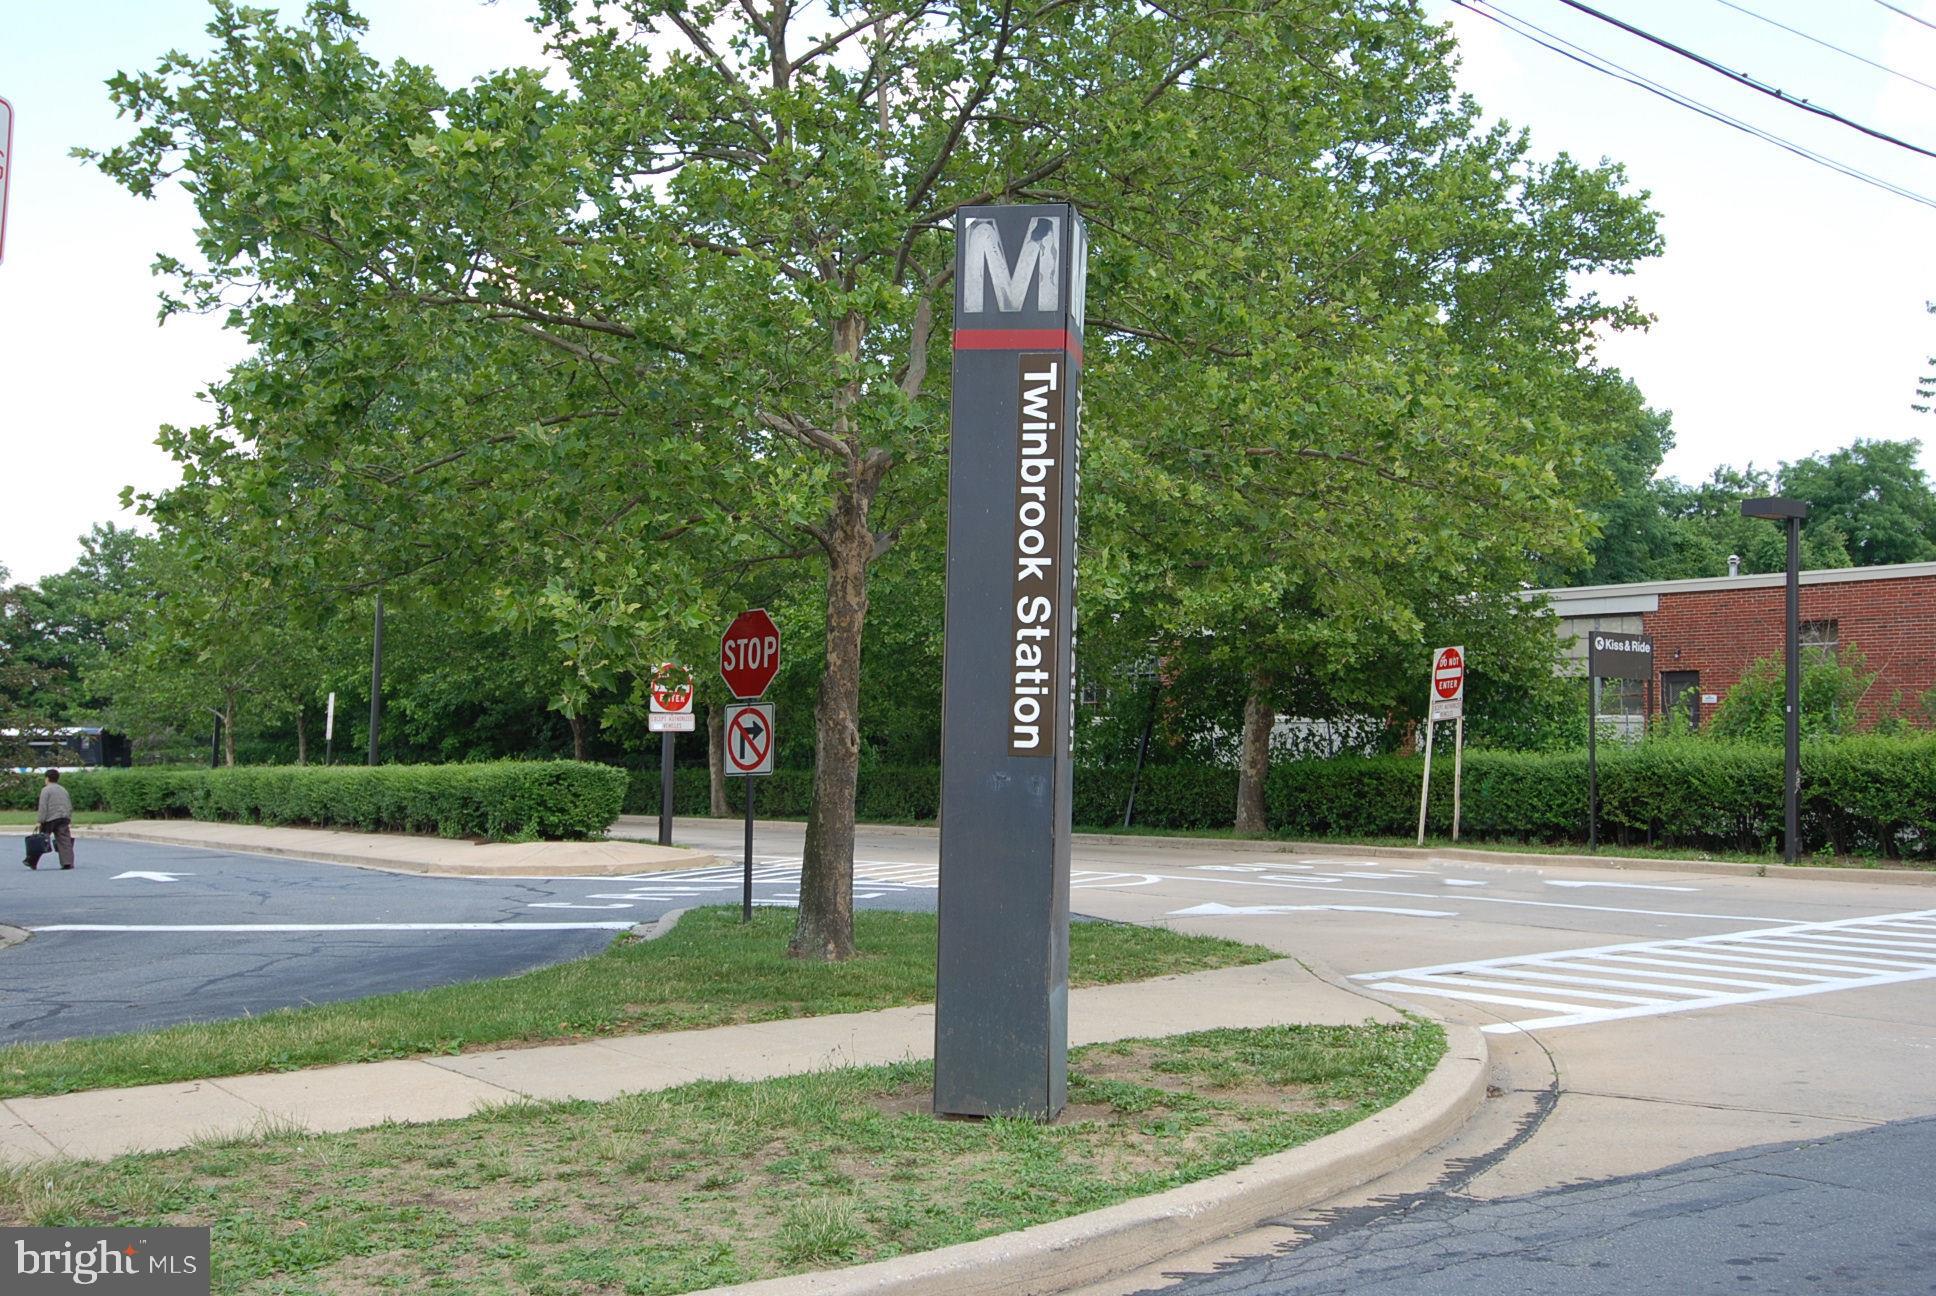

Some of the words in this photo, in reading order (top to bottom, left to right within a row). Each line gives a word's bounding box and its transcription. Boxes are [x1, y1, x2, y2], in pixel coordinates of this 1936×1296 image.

[964, 217, 1060, 313] M
[1018, 362, 1058, 581] Twinbrook
[723, 636, 777, 672] STOP
[1440, 658, 1448, 668] DO
[1448, 657, 1459, 667] NOT
[1605, 638, 1624, 651] Kiss
[1624, 640, 1631, 651] &
[1631, 640, 1651, 653] Ride
[1013, 595, 1052, 749] Station
[1439, 679, 1458, 690] ENTER
